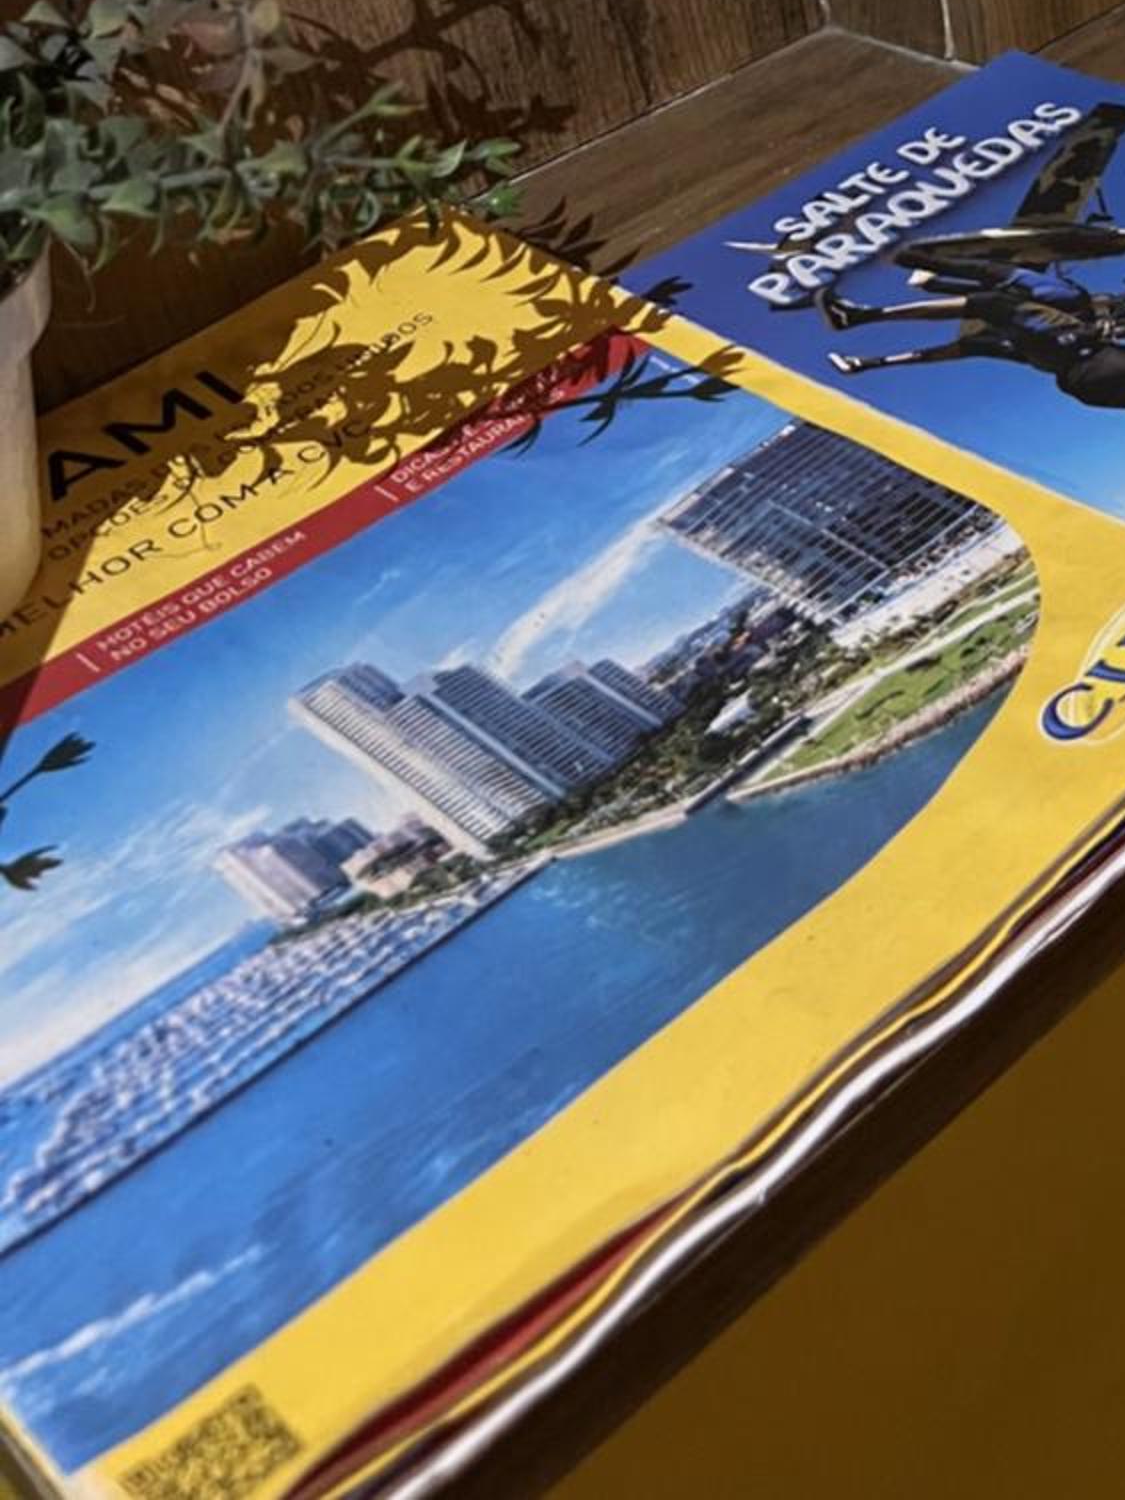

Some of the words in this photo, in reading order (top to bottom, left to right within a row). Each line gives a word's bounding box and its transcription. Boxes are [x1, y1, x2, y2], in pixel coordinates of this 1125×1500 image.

[748, 100, 1083, 303] PARAQUEDAS
[775, 162, 908, 240] SALTE
[899, 127, 966, 166] DE
[168, 484, 259, 538] COM
[268, 466, 294, 485] A
[297, 421, 368, 463] CVC
[97, 602, 180, 651] HOTÉIS
[182, 574, 228, 605] QUE
[229, 531, 306, 577] CABEM
[109, 636, 148, 662] NO
[149, 610, 197, 639] SEU
[198, 566, 274, 613] BOLSO
